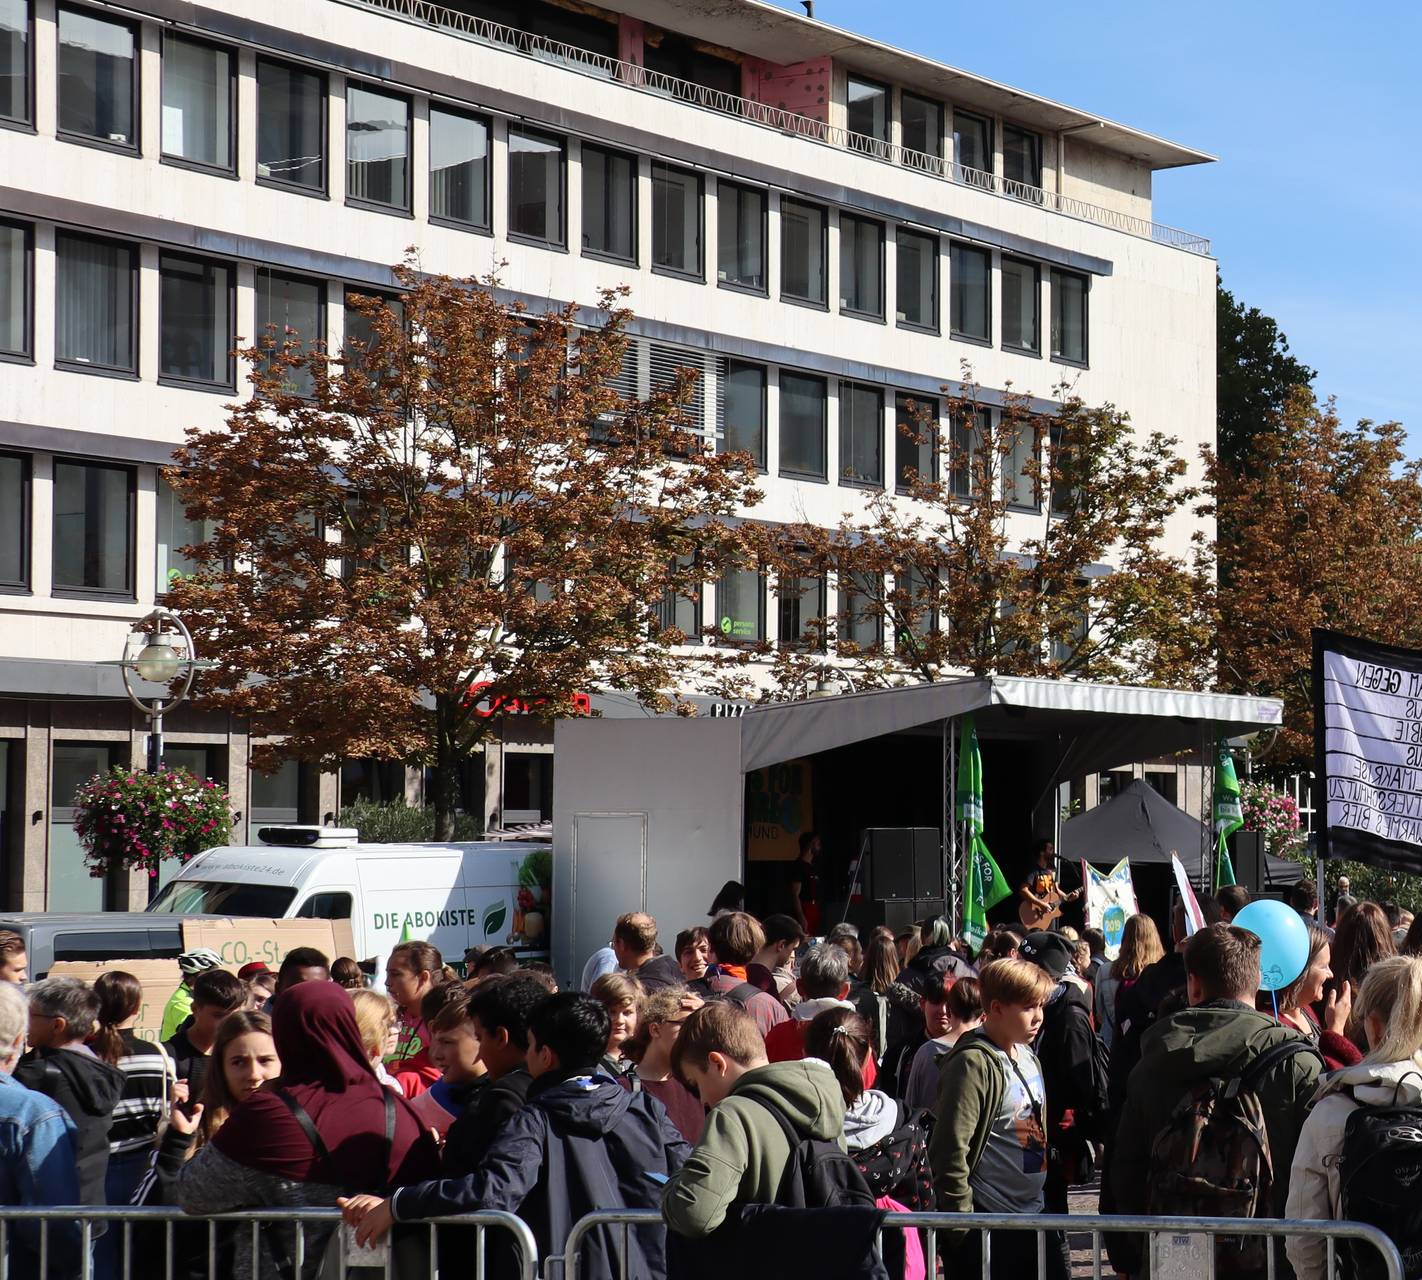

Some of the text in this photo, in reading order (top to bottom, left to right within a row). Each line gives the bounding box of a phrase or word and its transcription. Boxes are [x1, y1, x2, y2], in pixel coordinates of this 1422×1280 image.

[715, 703, 752, 717] PIZZ
[201, 863, 285, 876] www.abokiste24.de
[374, 904, 476, 930] DIE ABOKISTE
